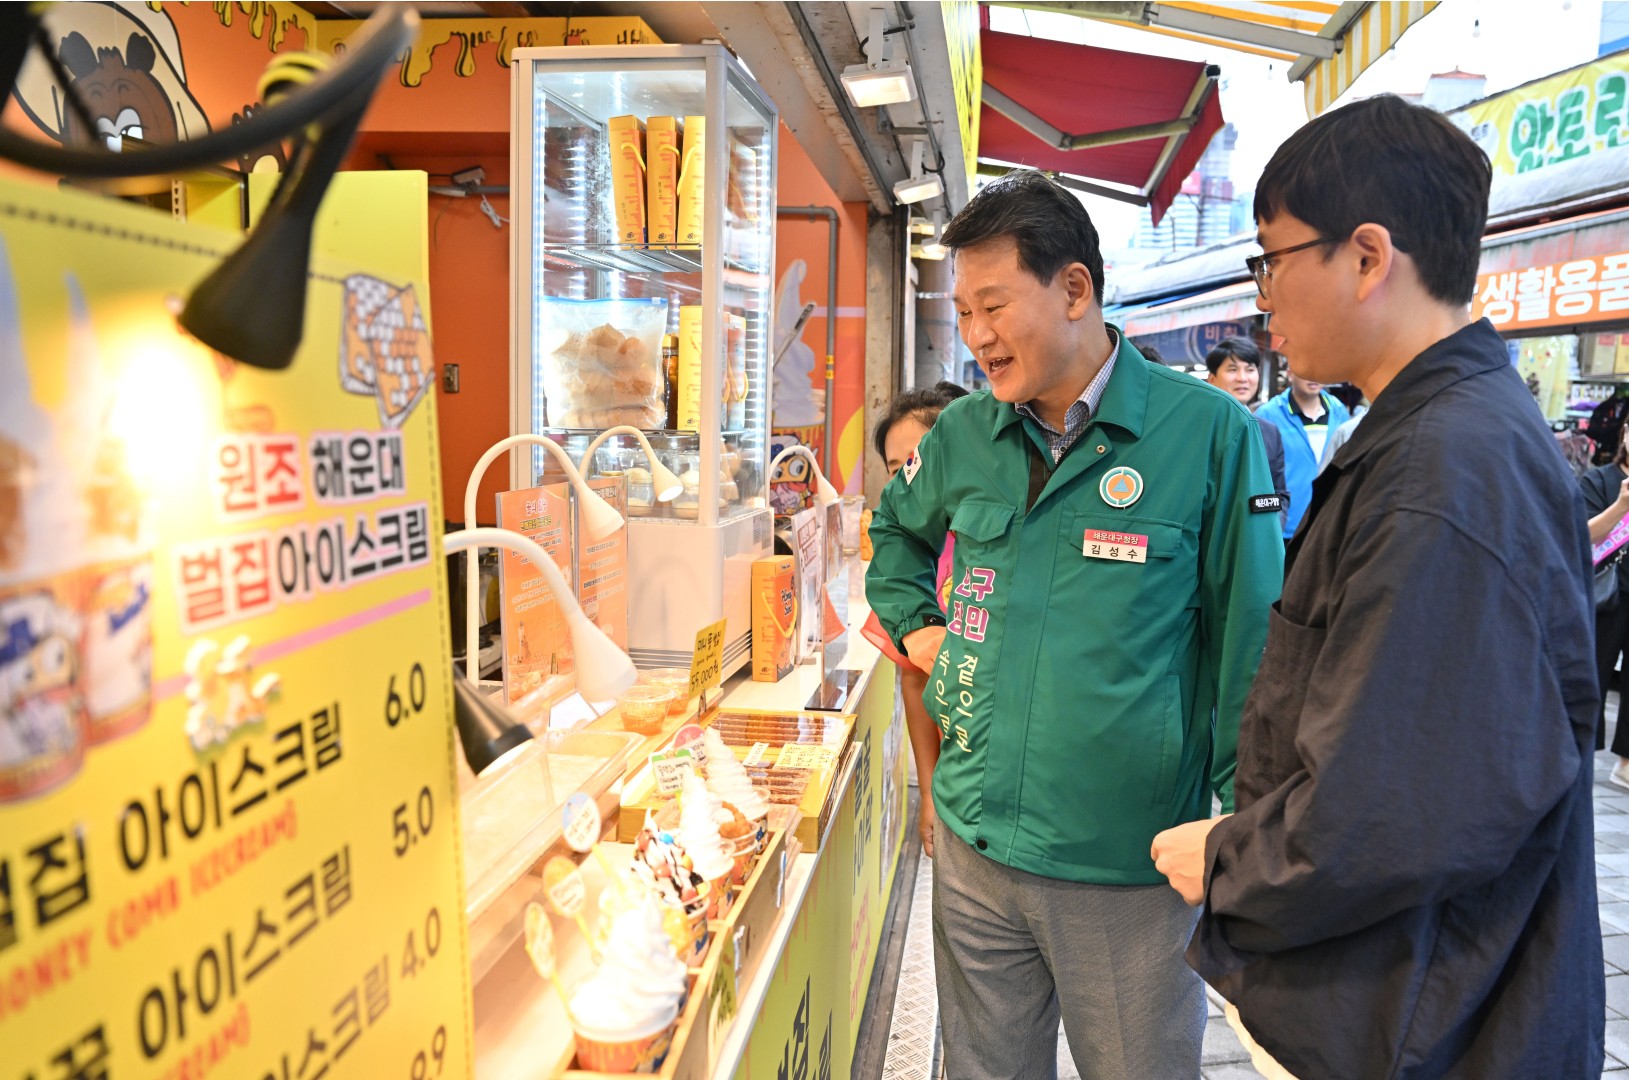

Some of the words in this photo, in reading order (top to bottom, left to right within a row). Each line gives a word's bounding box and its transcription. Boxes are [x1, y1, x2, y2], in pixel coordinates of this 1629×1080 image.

[1480, 253, 1629, 325] 생활용품
[219, 441, 300, 513] 원조
[310, 435, 405, 499] 해운대
[180, 507, 429, 625] 벌집아이스크림
[1093, 531, 1140, 545] 해운대구청장
[118, 701, 344, 872] 아이스크림
[384, 662, 427, 729] 6.0
[138, 844, 353, 1059] 아이스크림
[392, 785, 436, 858] 5.0
[400, 905, 442, 980] 4.0
